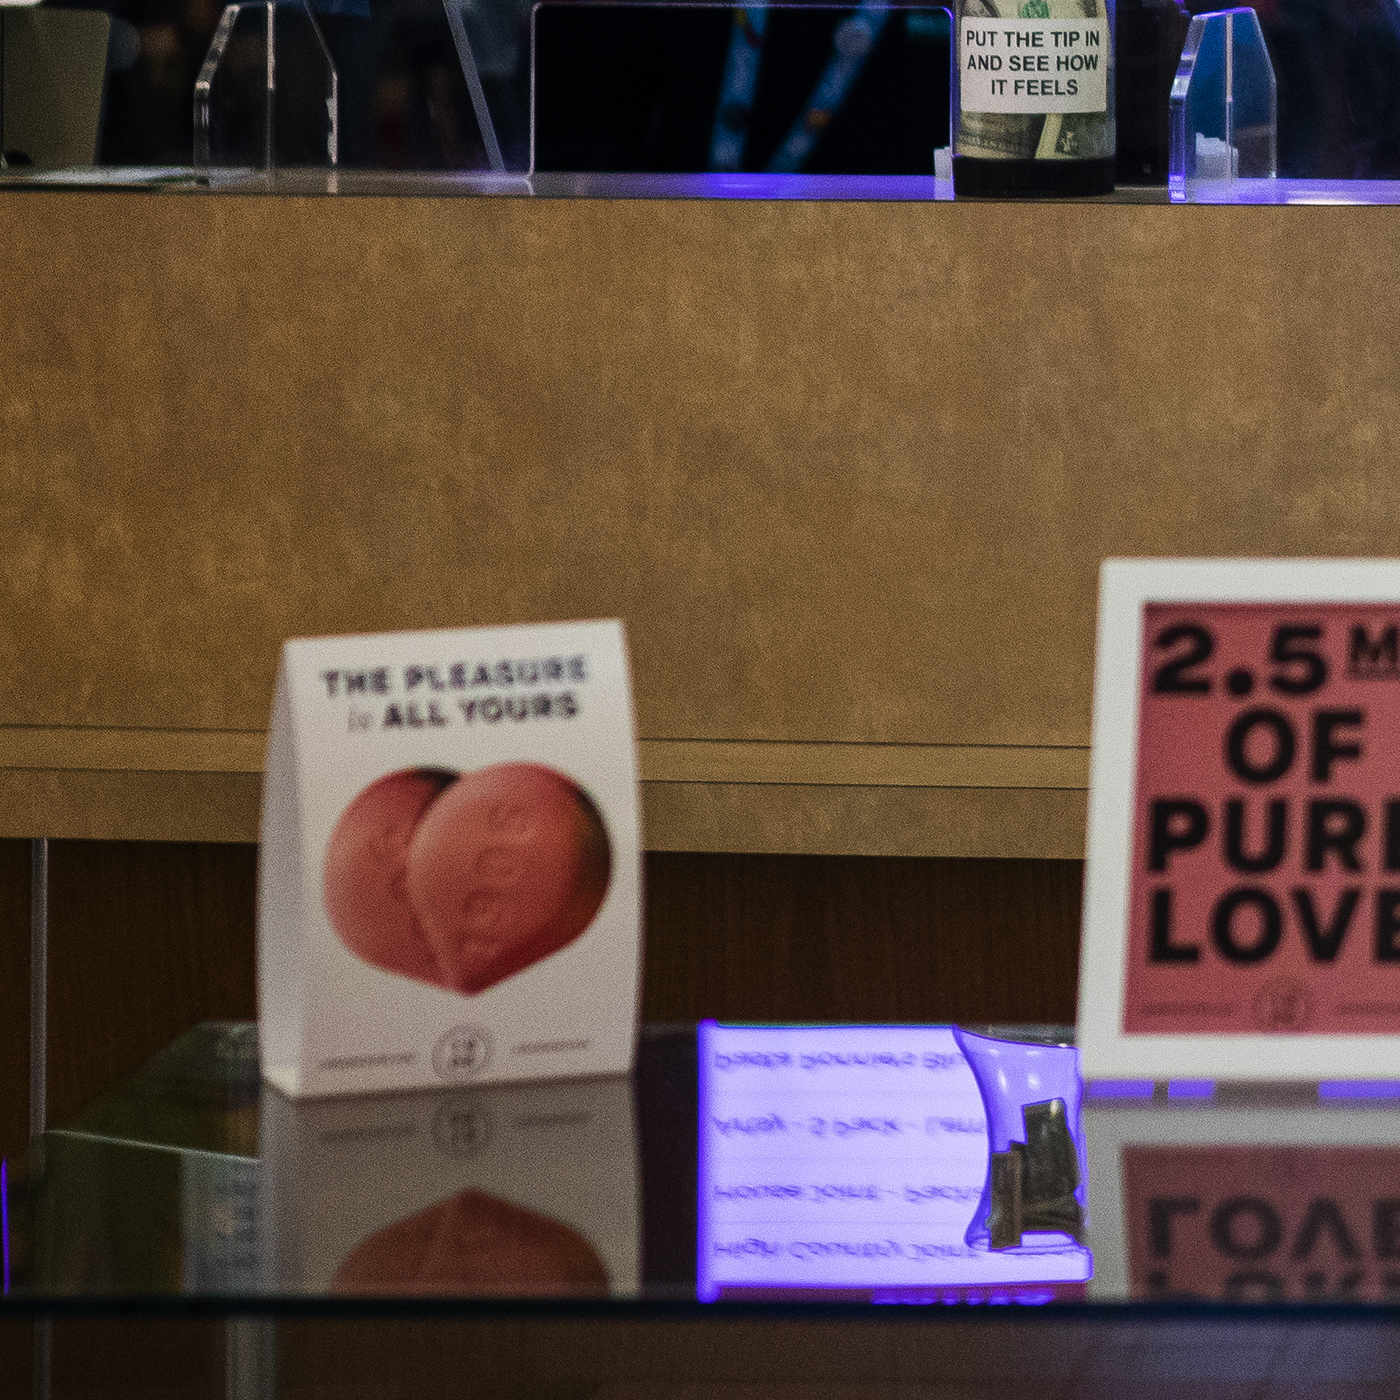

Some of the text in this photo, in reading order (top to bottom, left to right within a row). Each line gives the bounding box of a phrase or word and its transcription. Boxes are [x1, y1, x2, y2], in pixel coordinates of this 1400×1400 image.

[966, 29, 1100, 48] PUT THE TIP IN
[967, 54, 1099, 72] AND SEE HOW
[991, 78, 1079, 96] IT FEELS
[321, 654, 588, 698] THE PLEASURE
[1149, 620, 1330, 698] 2.5
[383, 701, 448, 730] ALL
[457, 692, 579, 724] YOURS
[1224, 705, 1366, 786] OF
